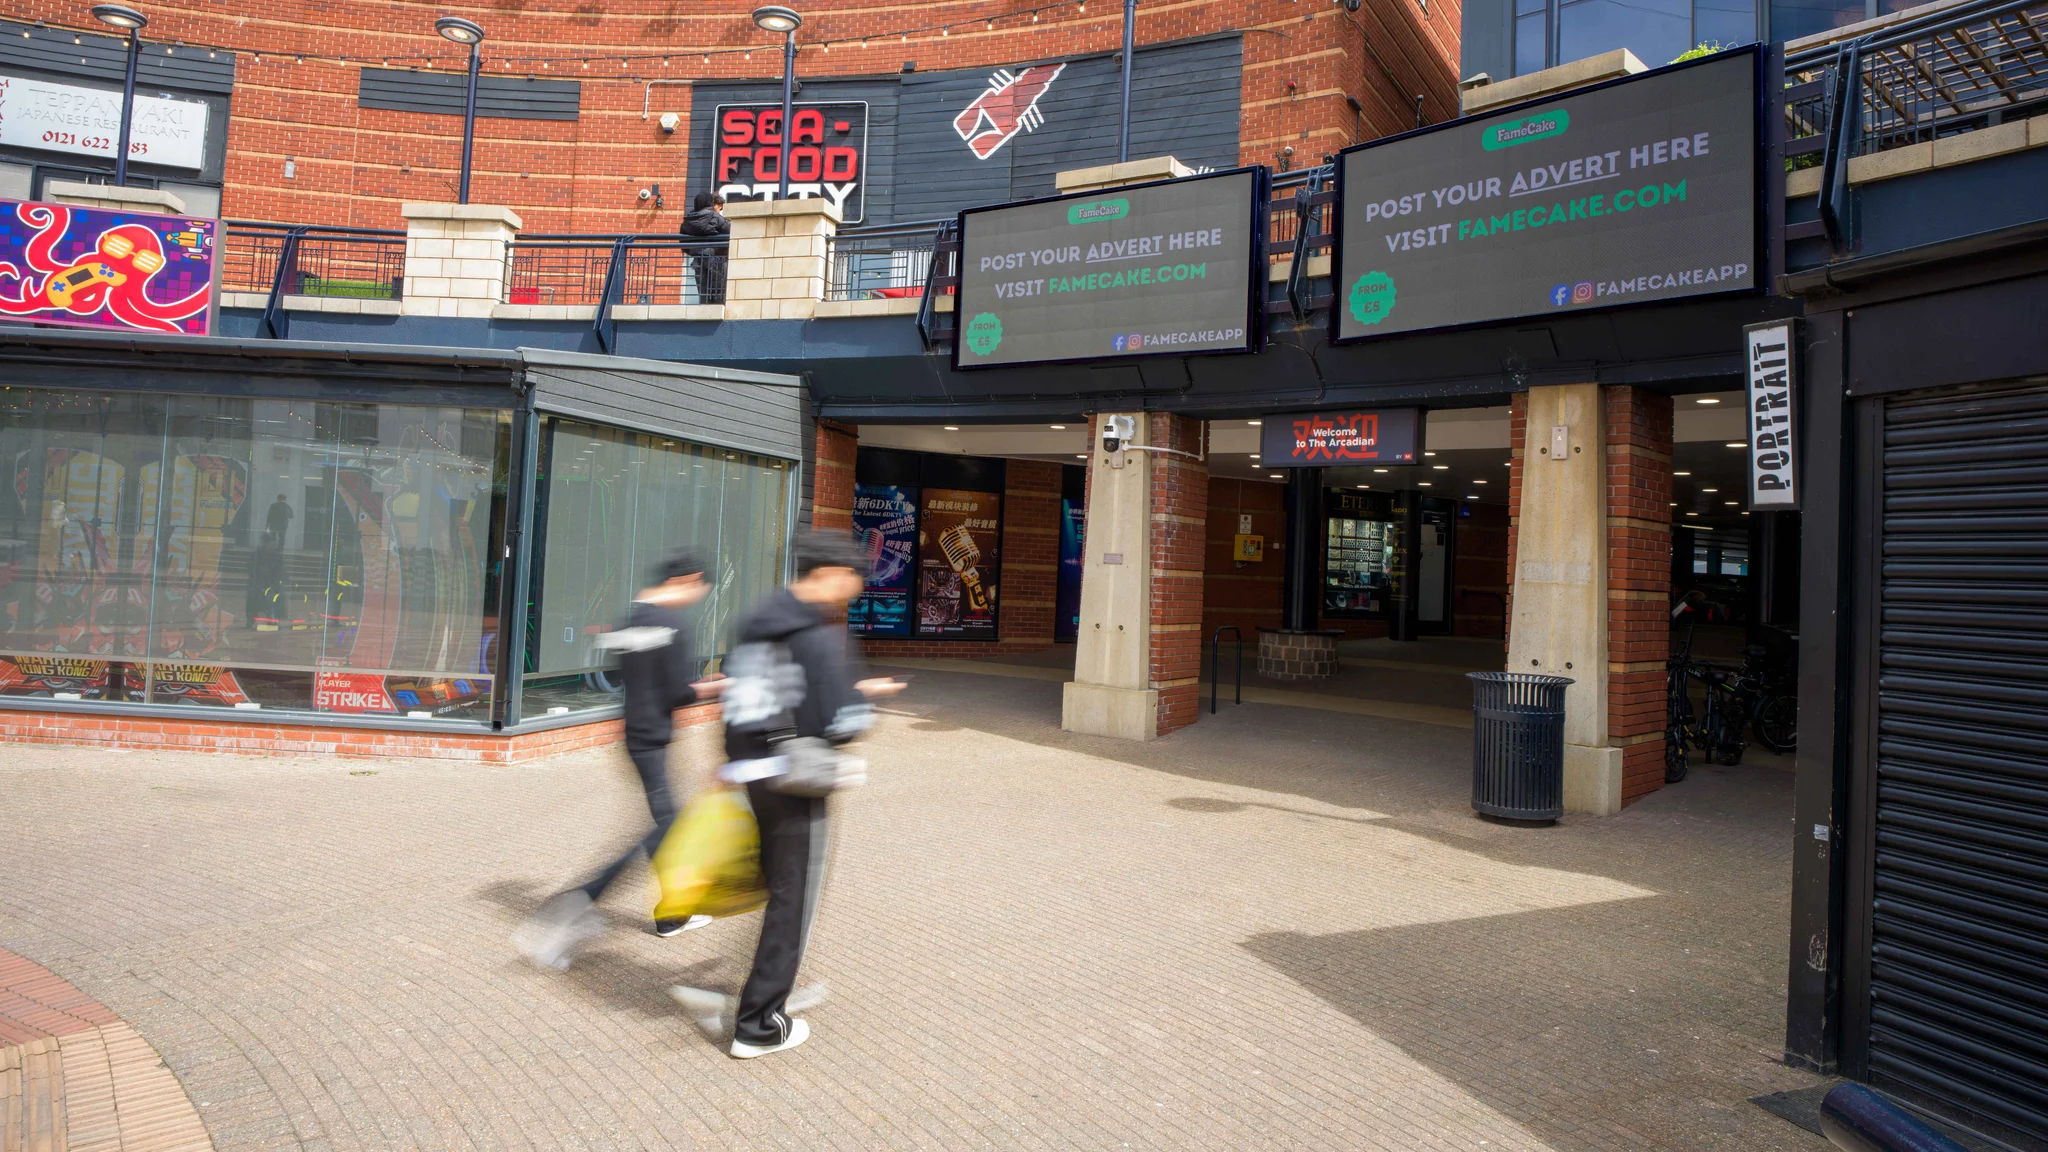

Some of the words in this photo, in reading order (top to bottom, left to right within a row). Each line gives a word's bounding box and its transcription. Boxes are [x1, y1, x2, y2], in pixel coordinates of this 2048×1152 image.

[17, 107, 90, 127] JAPANESE
[93, 117, 190, 140] RESAURANT
[1496, 117, 1557, 144] FameCake
[42, 130, 76, 145] 0121
[81, 136, 110, 150] 622
[116, 141, 148, 156] 83
[718, 146, 858, 182] FOOD
[1366, 192, 1427, 223] POST
[1432, 176, 1502, 211] YOUR
[1508, 149, 1622, 196] ADVERT
[1629, 131, 1711, 170] HERE
[1078, 203, 1121, 220] FameCake
[1385, 223, 1453, 253] VISIT
[1458, 178, 1688, 242] FAMECAKE.COM
[980, 252, 1025, 273] POST
[1030, 245, 1081, 266] YOUR
[1085, 235, 1164, 262] ADVERT
[1169, 227, 1222, 251] HERE
[995, 279, 1045, 300] VISIT
[1049, 261, 1207, 295] FAMECAKE.COM
[1596, 262, 1749, 297] FAMECAKEAPP
[1358, 282, 1388, 297] FROM
[1363, 301, 1381, 314] £5
[973, 322, 996, 332] FROM
[977, 336, 990, 347] £5
[1143, 328, 1244, 347] FAMECAKEAPP
[1753, 342, 1791, 491] PORTRAIT
[1291, 412, 1379, 461] 欢迎
[1313, 427, 1358, 437] Welcome
[1296, 440, 1306, 448] to
[1308, 438, 1327, 448] The
[1329, 436, 1375, 447] Arcadian
[19, 663, 55, 675] KING
[57, 666, 92, 678] KONG
[138, 669, 174, 681] KNG
[176, 671, 211, 683] KONG
[318, 679, 351, 688] PLAYER
[317, 691, 381, 709] STRIKE
